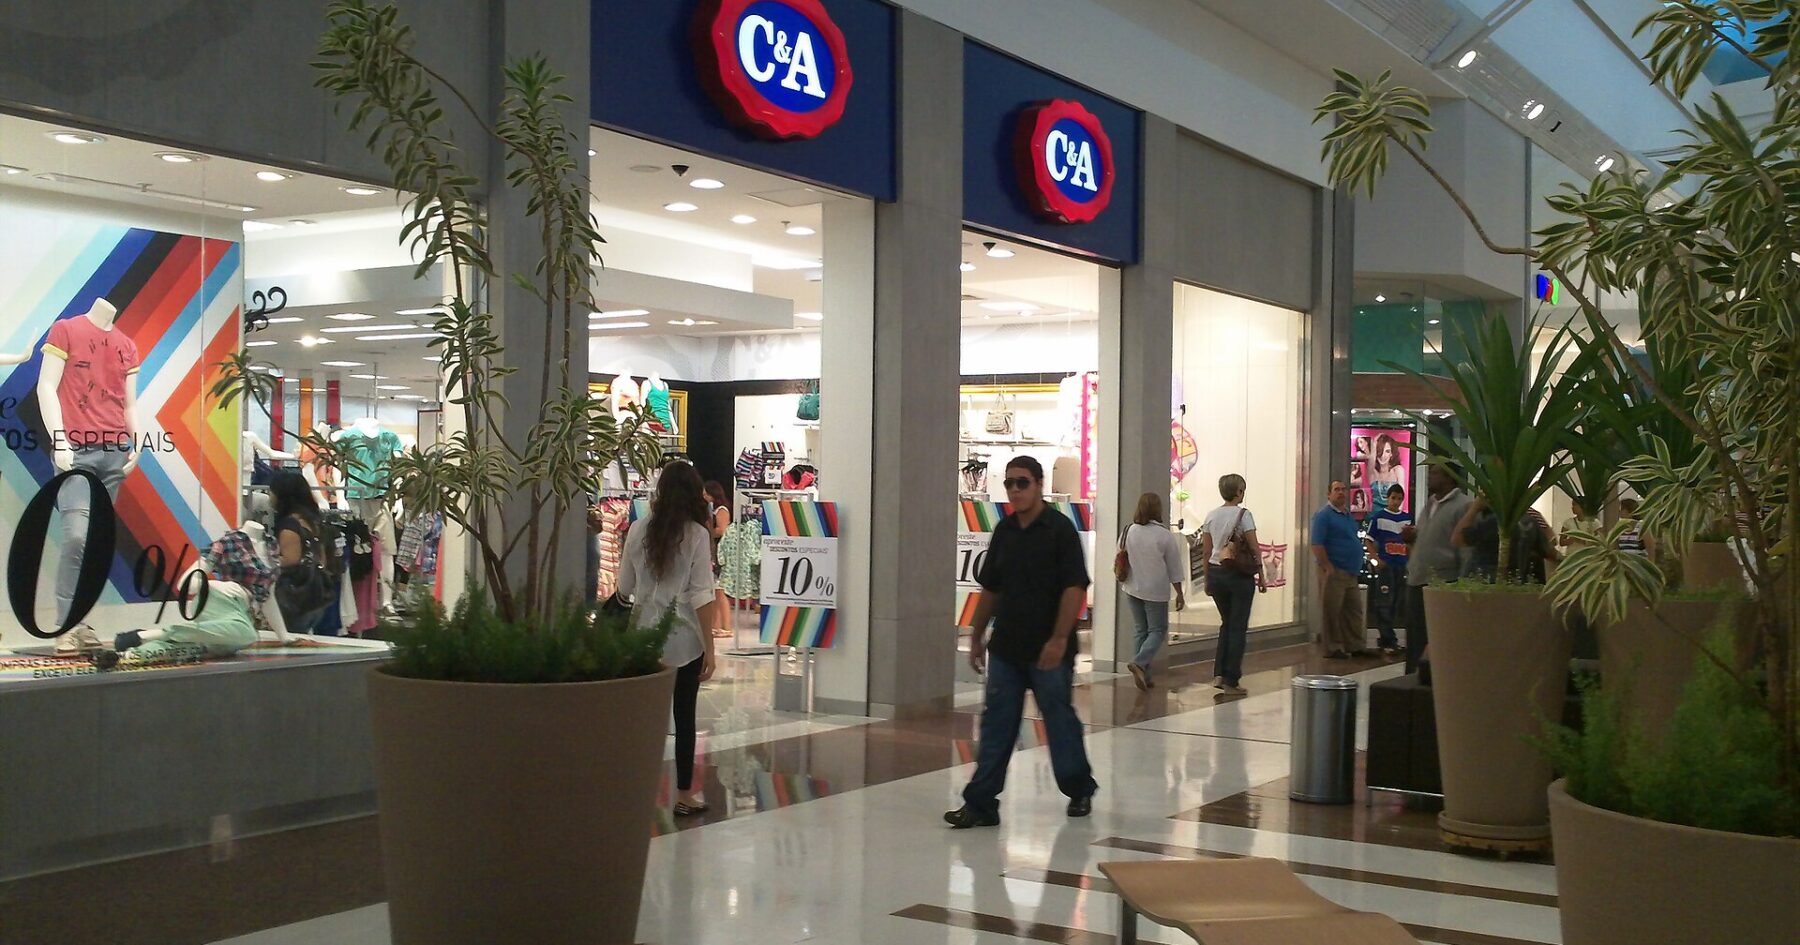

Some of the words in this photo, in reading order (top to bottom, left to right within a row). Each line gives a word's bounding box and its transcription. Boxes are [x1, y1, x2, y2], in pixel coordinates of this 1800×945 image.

[738, 14, 826, 99] C&A
[1045, 129, 1098, 192] C&A
[52, 429, 175, 453] ESPECIAIS
